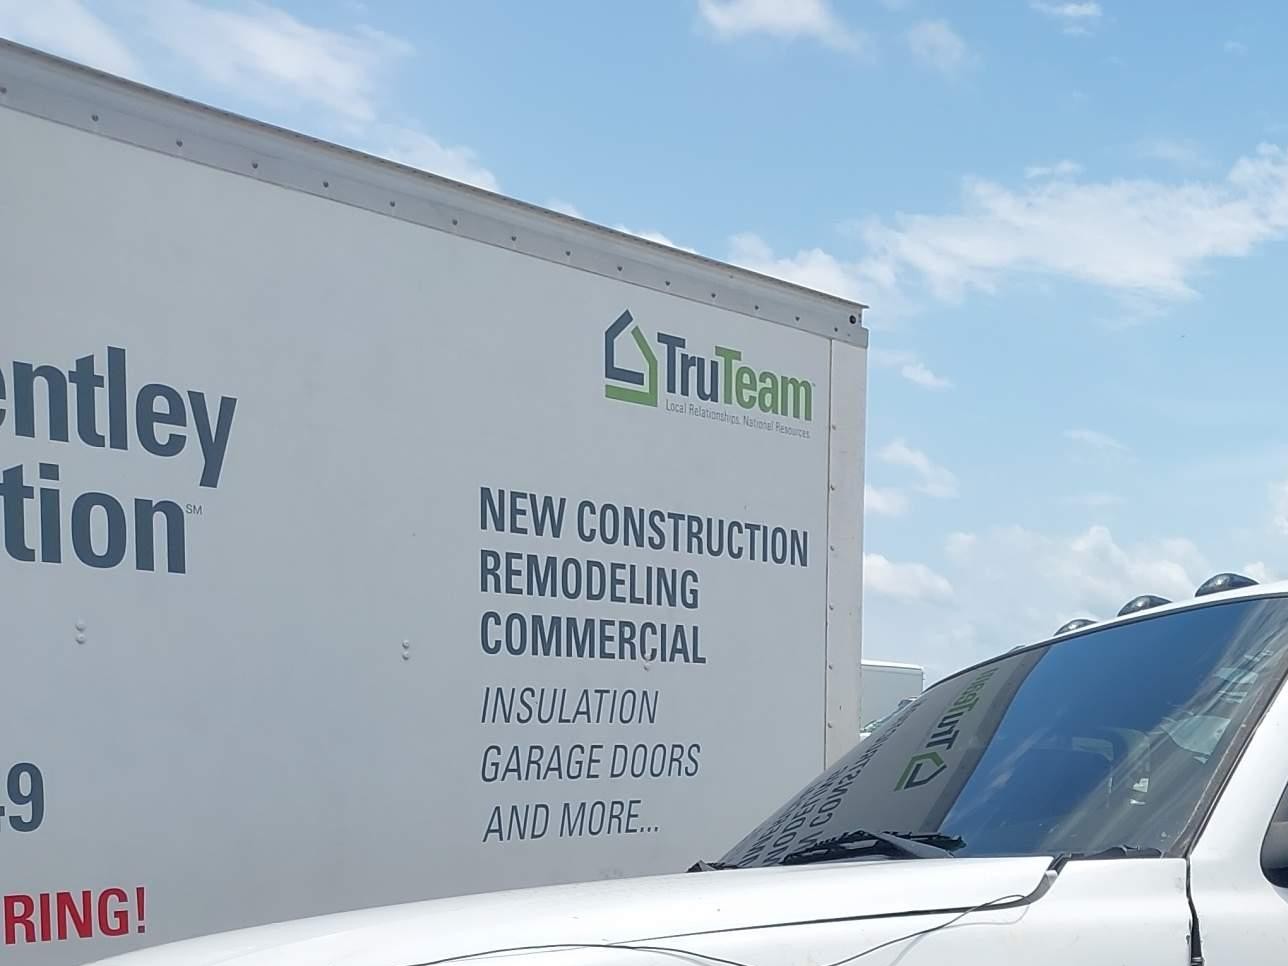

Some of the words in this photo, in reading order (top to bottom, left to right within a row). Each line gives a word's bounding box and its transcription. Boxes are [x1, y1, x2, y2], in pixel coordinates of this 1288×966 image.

[657, 332, 812, 421] TruTeam
[0, 346, 238, 488] ntley
[666, 399, 686, 415] Local
[743, 416, 774, 431] National
[480, 486, 566, 538] NEW
[577, 500, 808, 567] CONSTRUCTION
[480, 549, 699, 609] REMODELING
[481, 611, 706, 664] COMMERCIAL
[481, 687, 659, 724] INSULATION
[481, 745, 604, 782] GARAGE
[610, 744, 701, 778] DOORS
[482, 803, 550, 842] AND
[559, 800, 659, 837] MORE...
[4, 887, 145, 944] RING!
